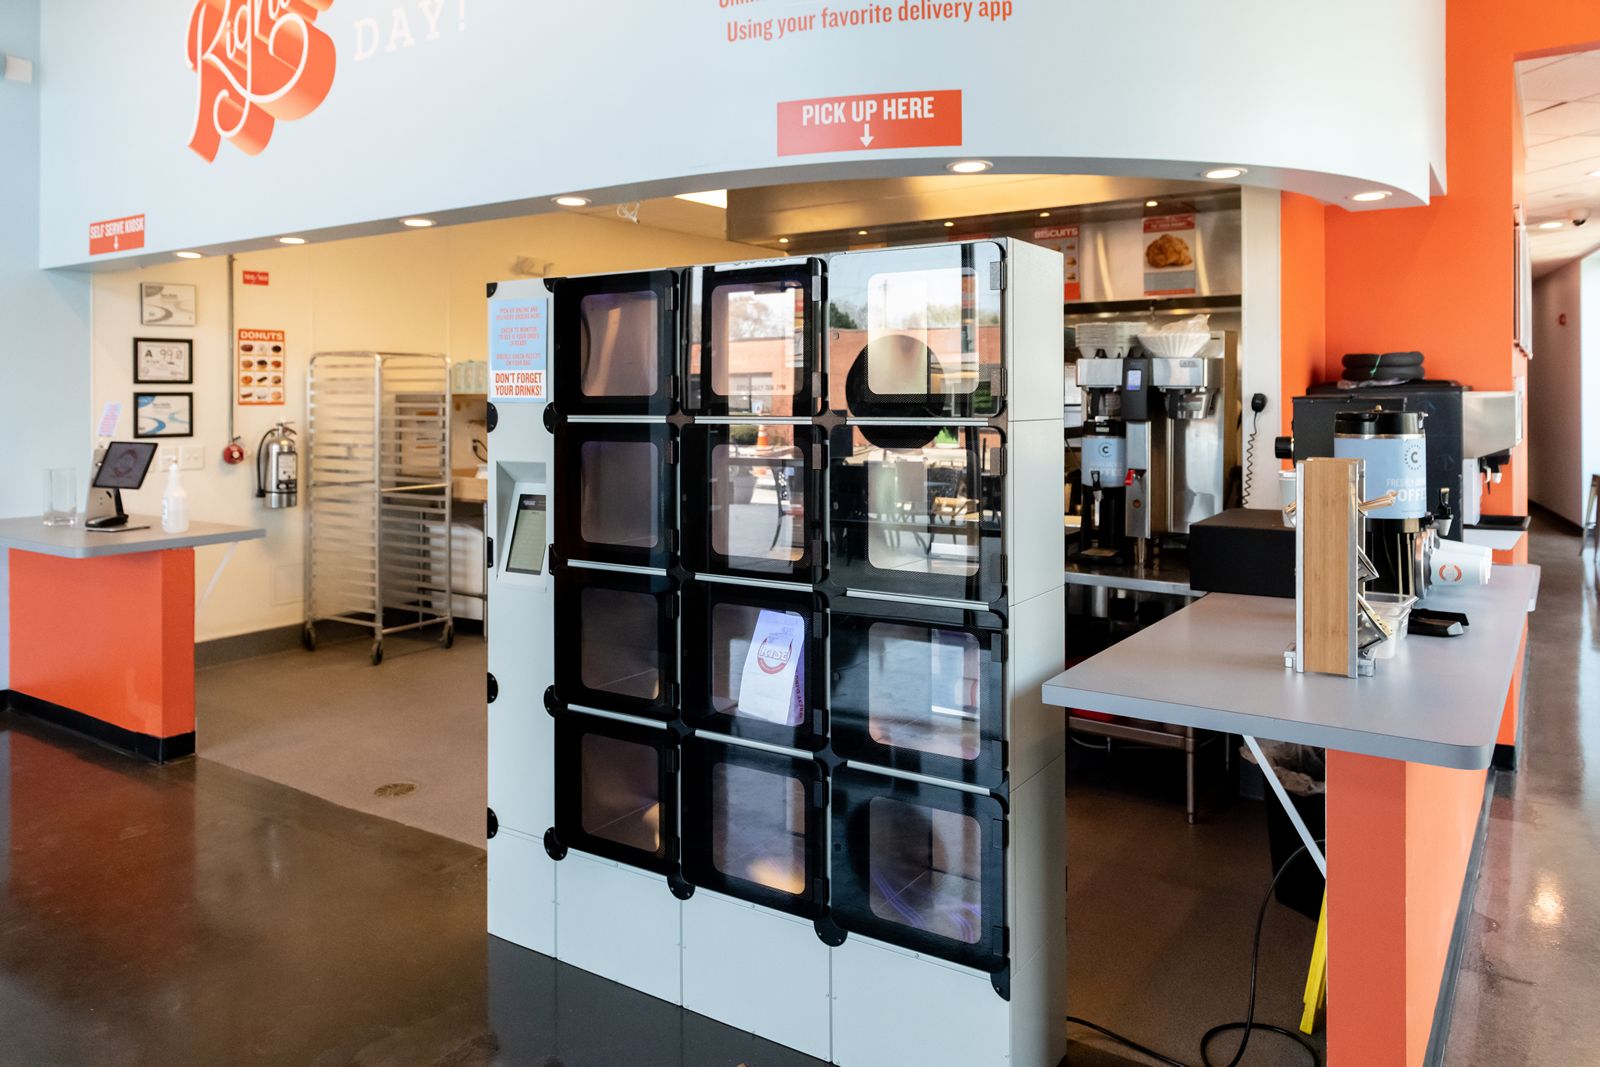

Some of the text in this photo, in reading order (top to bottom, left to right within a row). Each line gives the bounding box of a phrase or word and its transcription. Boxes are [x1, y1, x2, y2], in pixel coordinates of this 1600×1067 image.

[726, 0, 1013, 42] Using your favorite delivery app
[801, 96, 935, 127] PICK UP HERE
[90, 217, 144, 239] SELF SERVE KIOSK
[1034, 227, 1079, 239] BISCUITS
[240, 331, 283, 341] DONUTS
[495, 372, 542, 384] DON'T FORGET
[495, 385, 542, 396] YOUR DRINKS!
[1410, 451, 1418, 463] C
